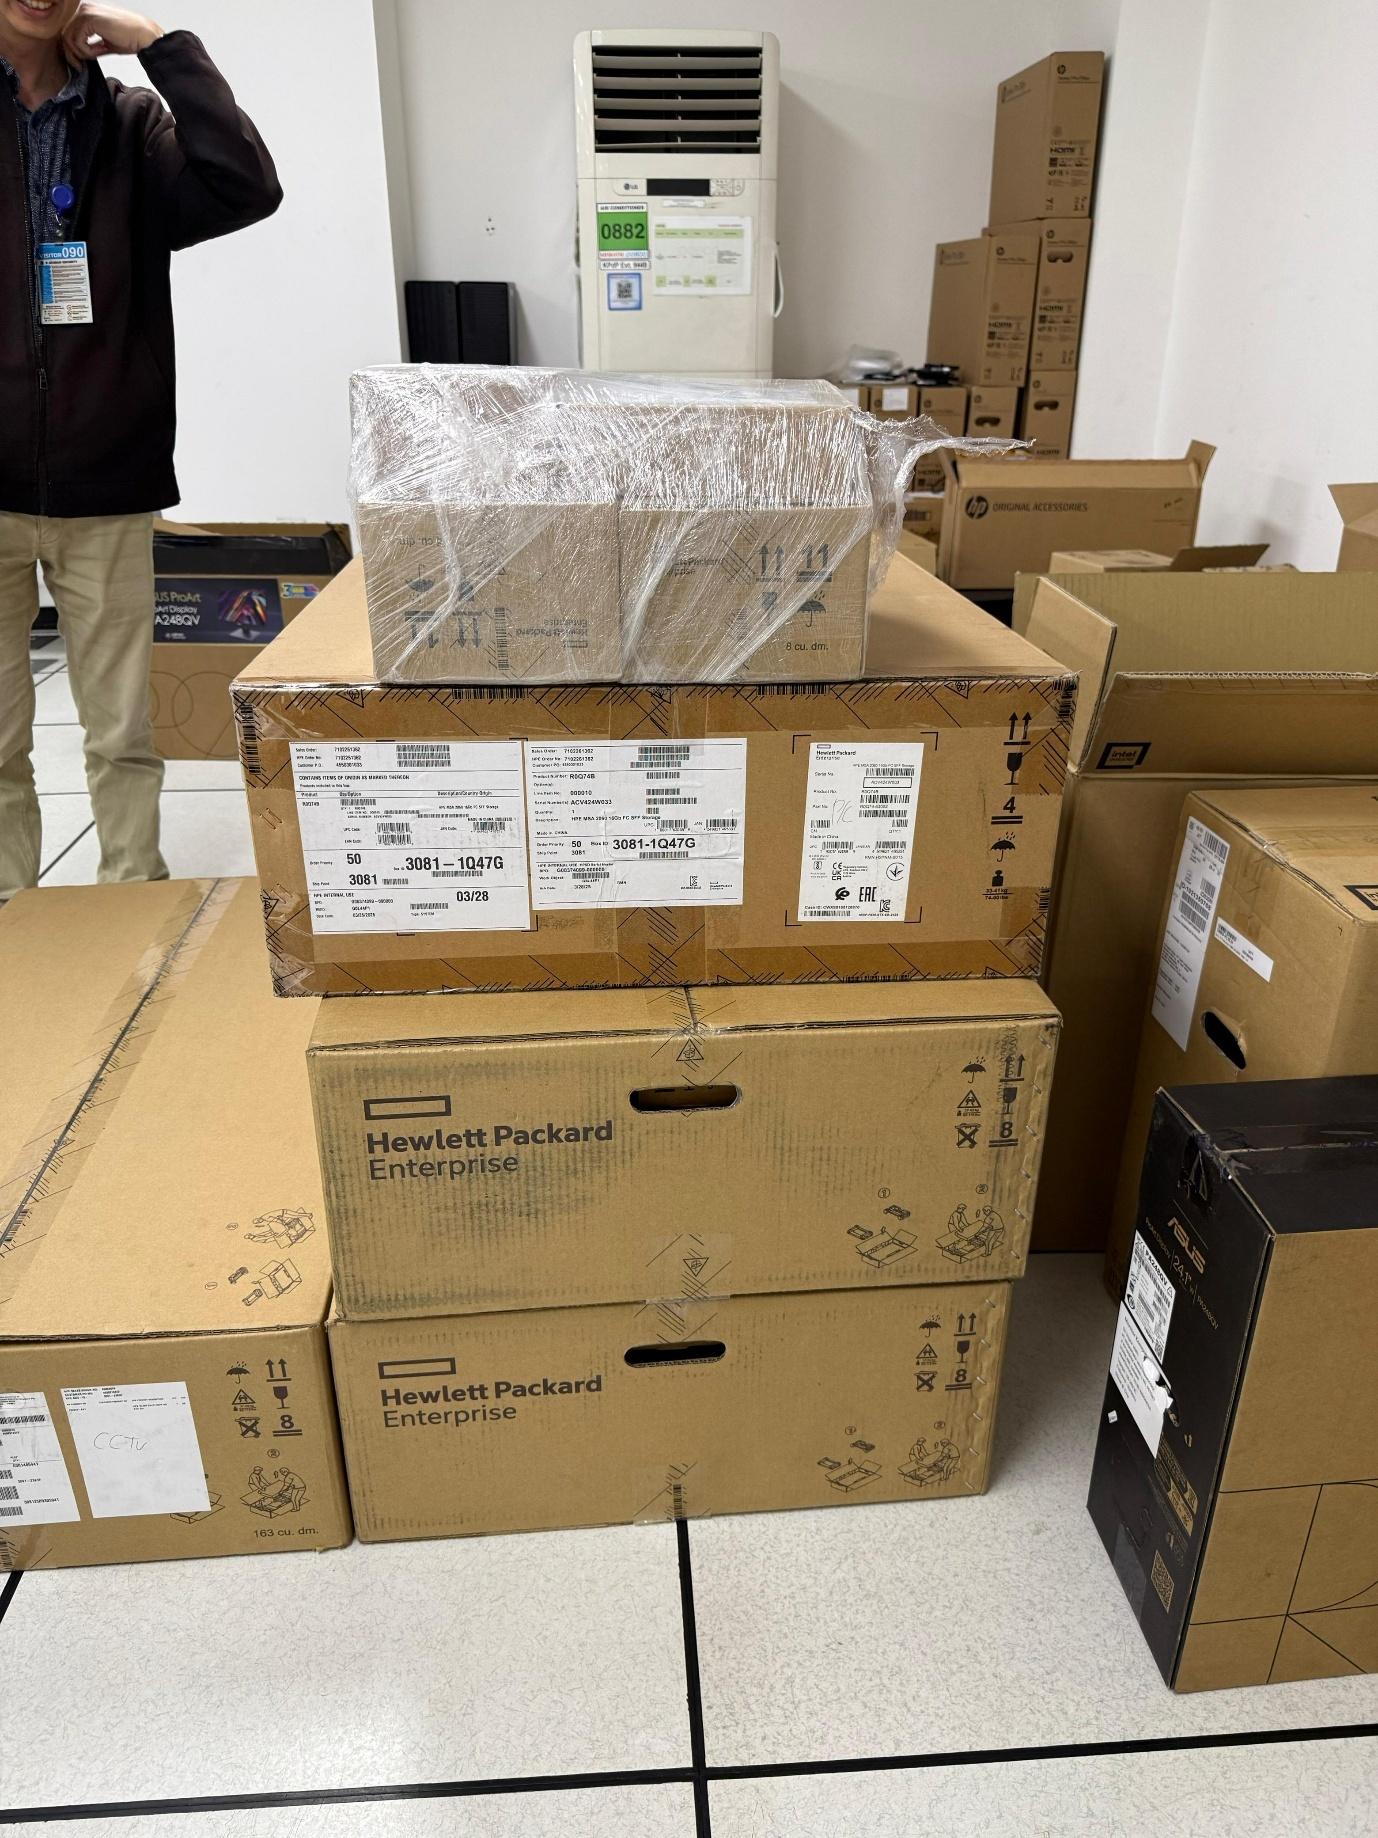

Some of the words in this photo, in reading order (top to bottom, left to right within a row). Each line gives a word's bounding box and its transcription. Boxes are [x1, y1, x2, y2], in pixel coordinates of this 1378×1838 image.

[601, 223, 645, 240] 0882
[62, 246, 84, 257] 090
[993, 502, 1030, 512] ORIGINAL
[1033, 502, 1088, 512] ACCESSORIES
[170, 592, 202, 603] ProArt
[169, 605, 198, 615] Display
[786, 642, 792, 651] 8
[794, 643, 808, 651] cu.
[811, 642, 829, 651] dm.
[1003, 796, 1016, 813] 4
[612, 838, 696, 850] 3081-1Q47G
[346, 853, 362, 865] 50
[349, 874, 377, 885] 3081
[832, 862, 843, 870] CE
[859, 886, 877, 902] EAC
[456, 891, 489, 903] 03/28
[367, 1128, 488, 1154] Hewlett
[494, 1120, 613, 1146] Packard
[1000, 1121, 1013, 1139] 8
[369, 1154, 519, 1180] Enterprise
[1167, 1216, 1206, 1274] ASUS
[955, 1368, 967, 1383] 8
[380, 1384, 489, 1407] Hewlett
[495, 1375, 602, 1399] Packard
[280, 1414, 295, 1429] 8
[383, 1404, 517, 1427] Enterprise
[254, 1529, 275, 1539] 163
[298, 1526, 320, 1536] dm.
